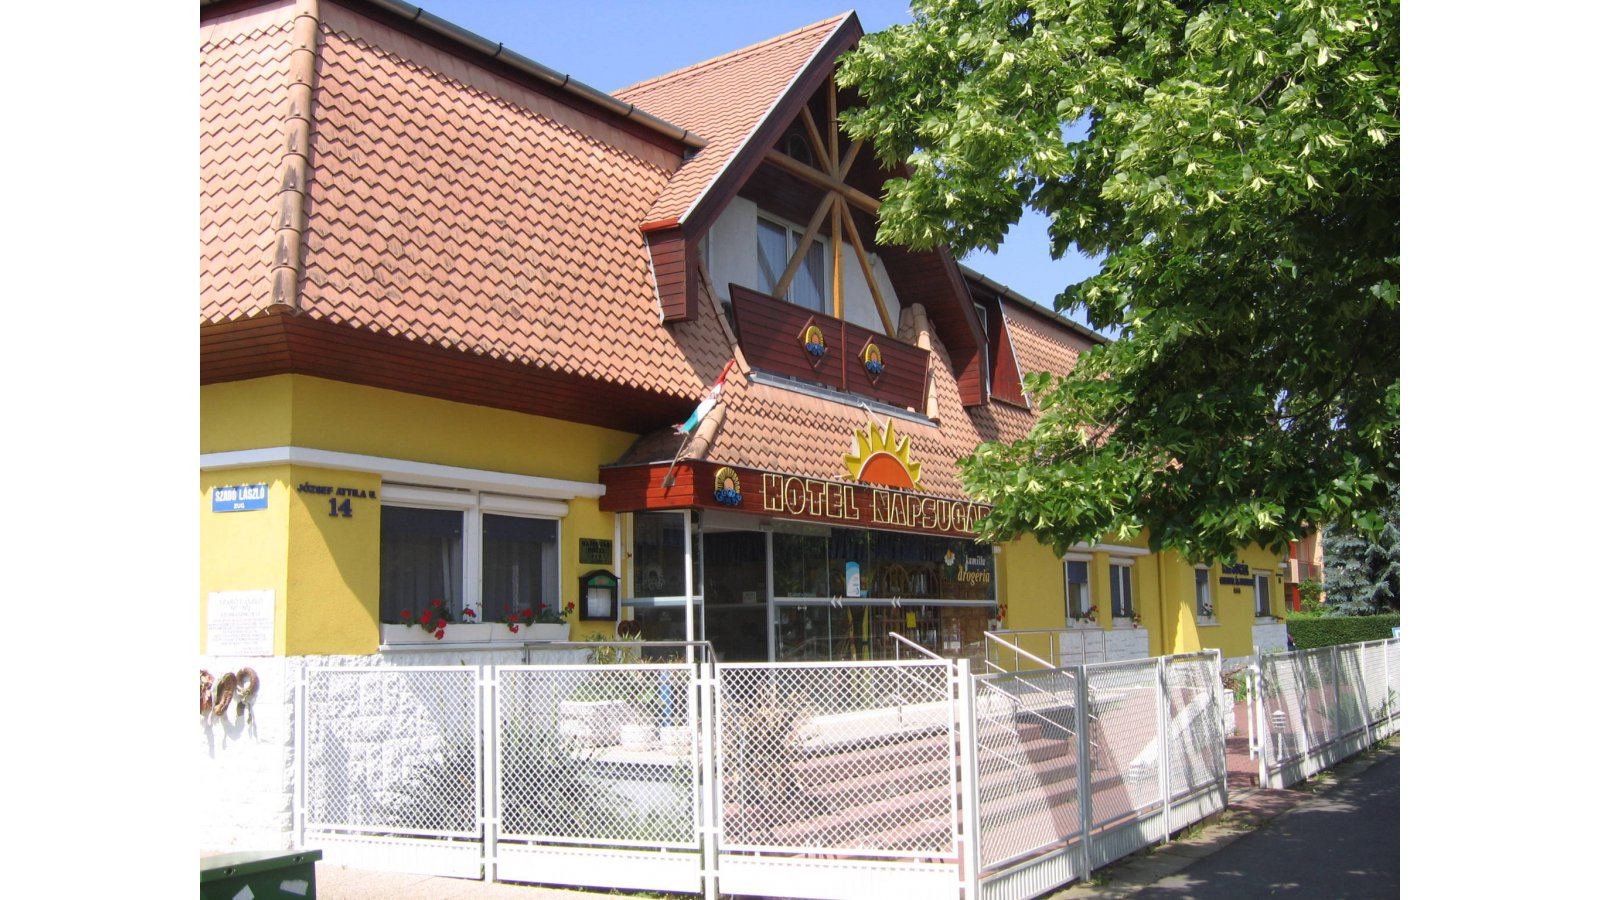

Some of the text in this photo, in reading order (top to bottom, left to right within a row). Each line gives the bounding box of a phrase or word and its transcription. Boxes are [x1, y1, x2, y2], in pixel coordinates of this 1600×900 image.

[215, 485, 265, 502] SZABÓ LÁSZLÓ
[297, 481, 334, 495] JÓZSEF
[336, 487, 367, 498] ATTILA
[763, 473, 860, 520] HOTEL
[328, 498, 352, 517] 14
[957, 564, 990, 586] drogéria
